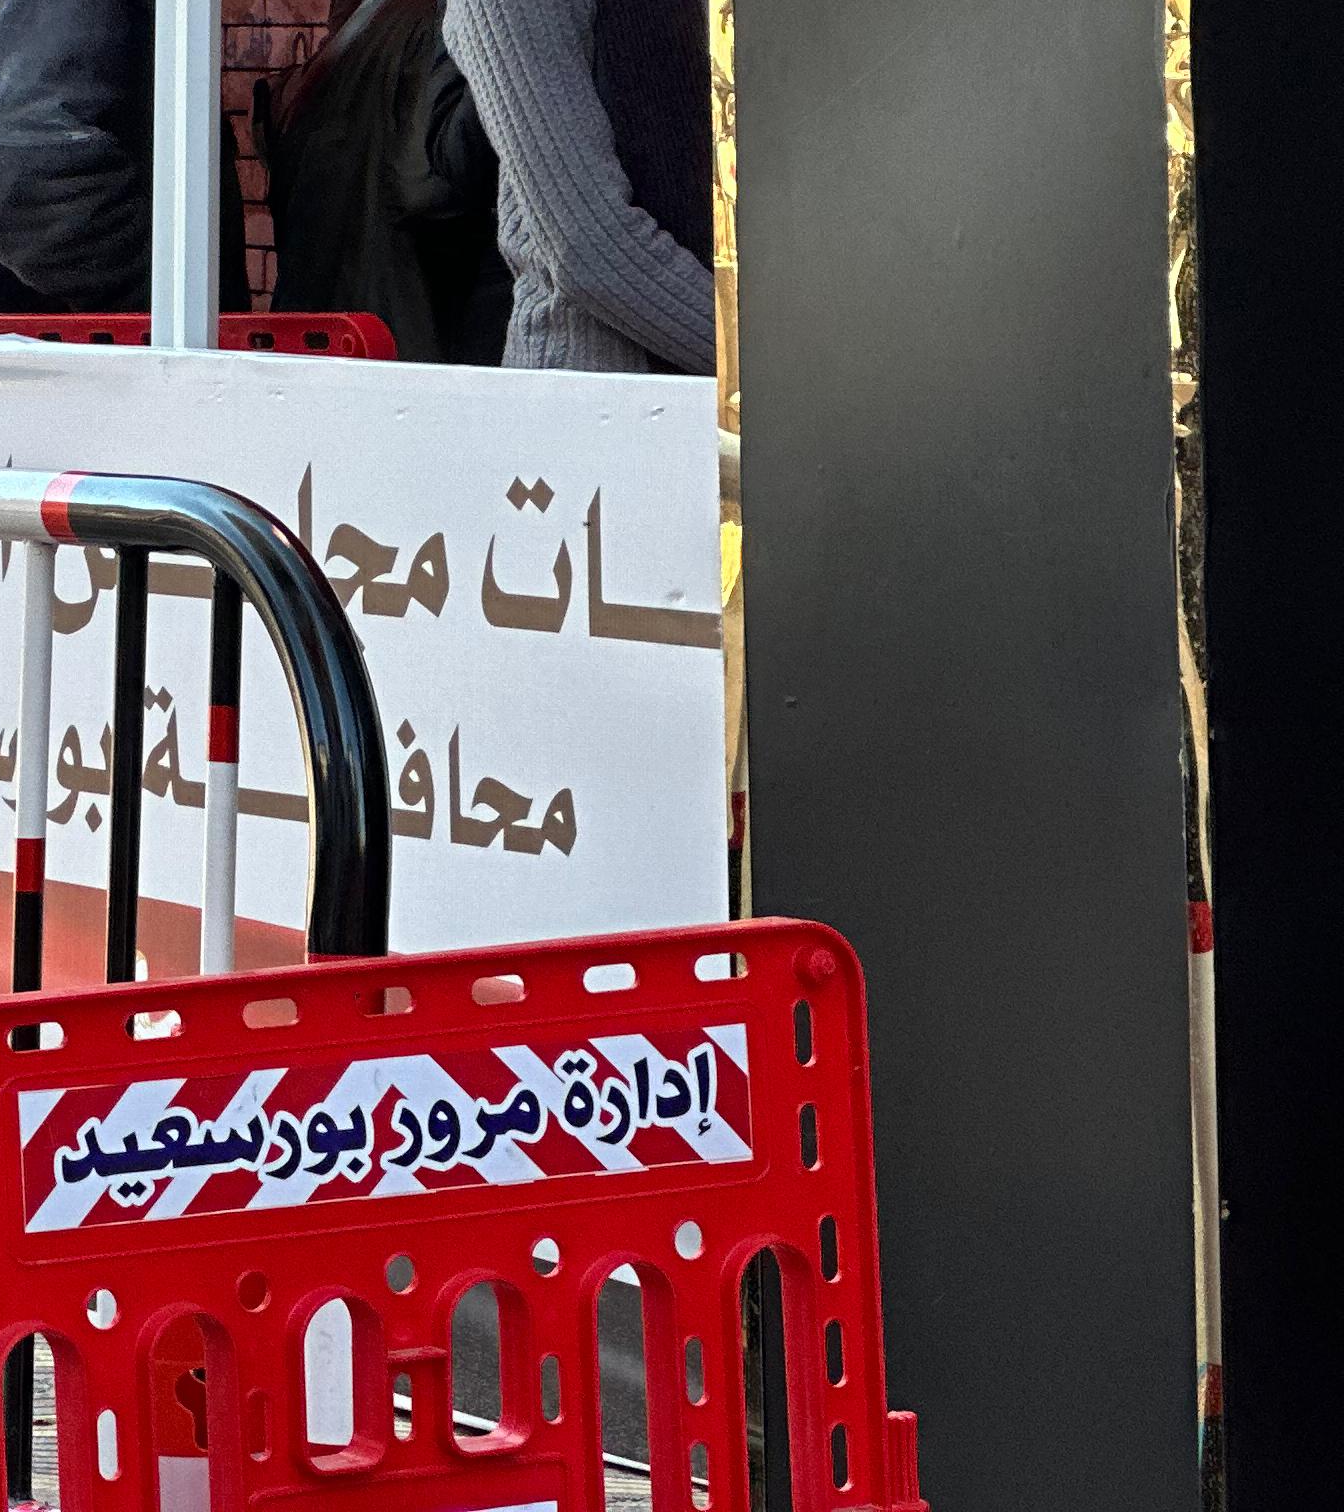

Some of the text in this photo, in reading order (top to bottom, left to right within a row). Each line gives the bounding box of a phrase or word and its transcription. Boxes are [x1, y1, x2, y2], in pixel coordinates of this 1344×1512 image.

[59, 1050, 717, 1206] إدارة مرور بورسعيد
